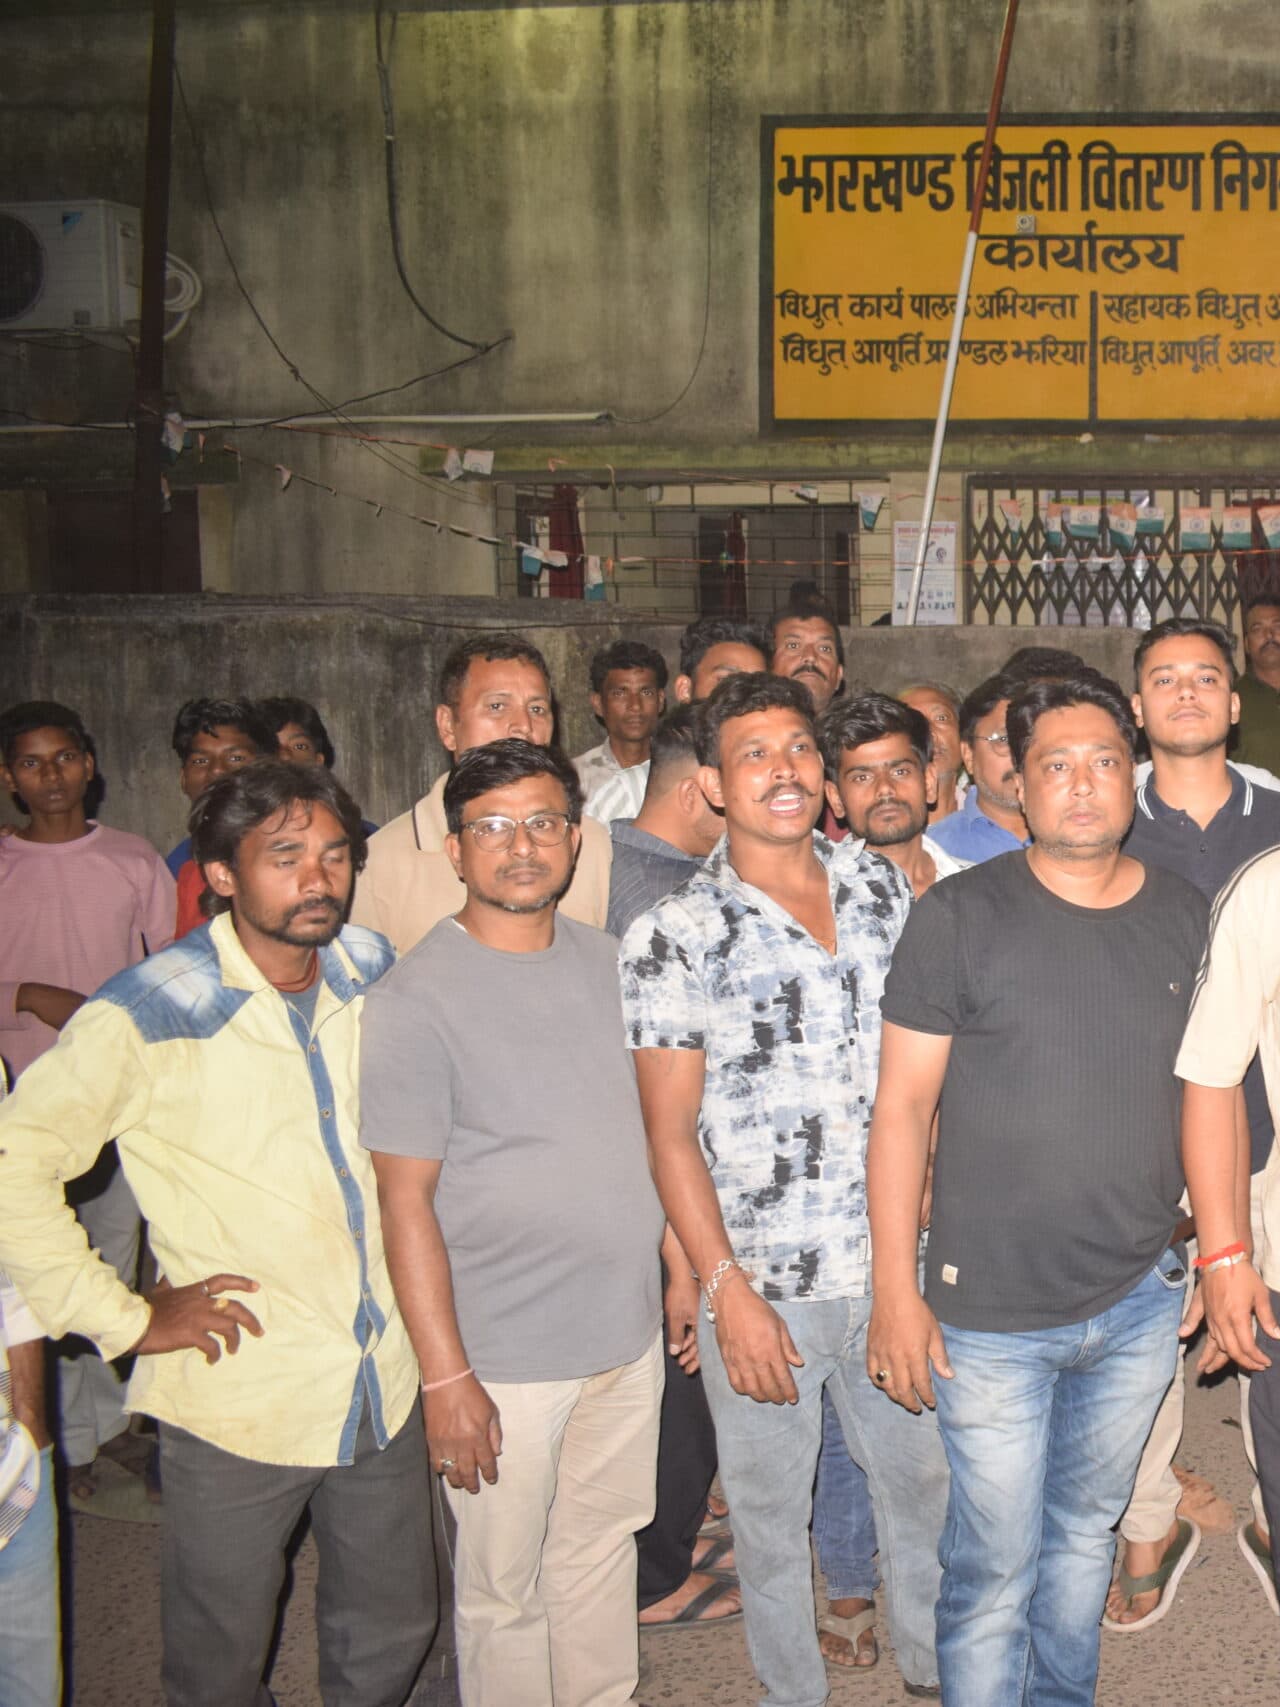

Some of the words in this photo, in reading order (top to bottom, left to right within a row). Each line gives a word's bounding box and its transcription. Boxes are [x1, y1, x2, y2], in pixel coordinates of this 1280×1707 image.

[777, 154, 955, 213] झारखण्ड
[962, 139, 1071, 212] बिजली
[1078, 139, 1205, 211] वितरण
[976, 220, 1184, 273] कार्यालय
[1102, 294, 1190, 323] सहायक
[852, 331, 923, 372] आपूर्ति
[1011, 334, 1088, 365] झरिया
[1227, 341, 1276, 367] अवर
